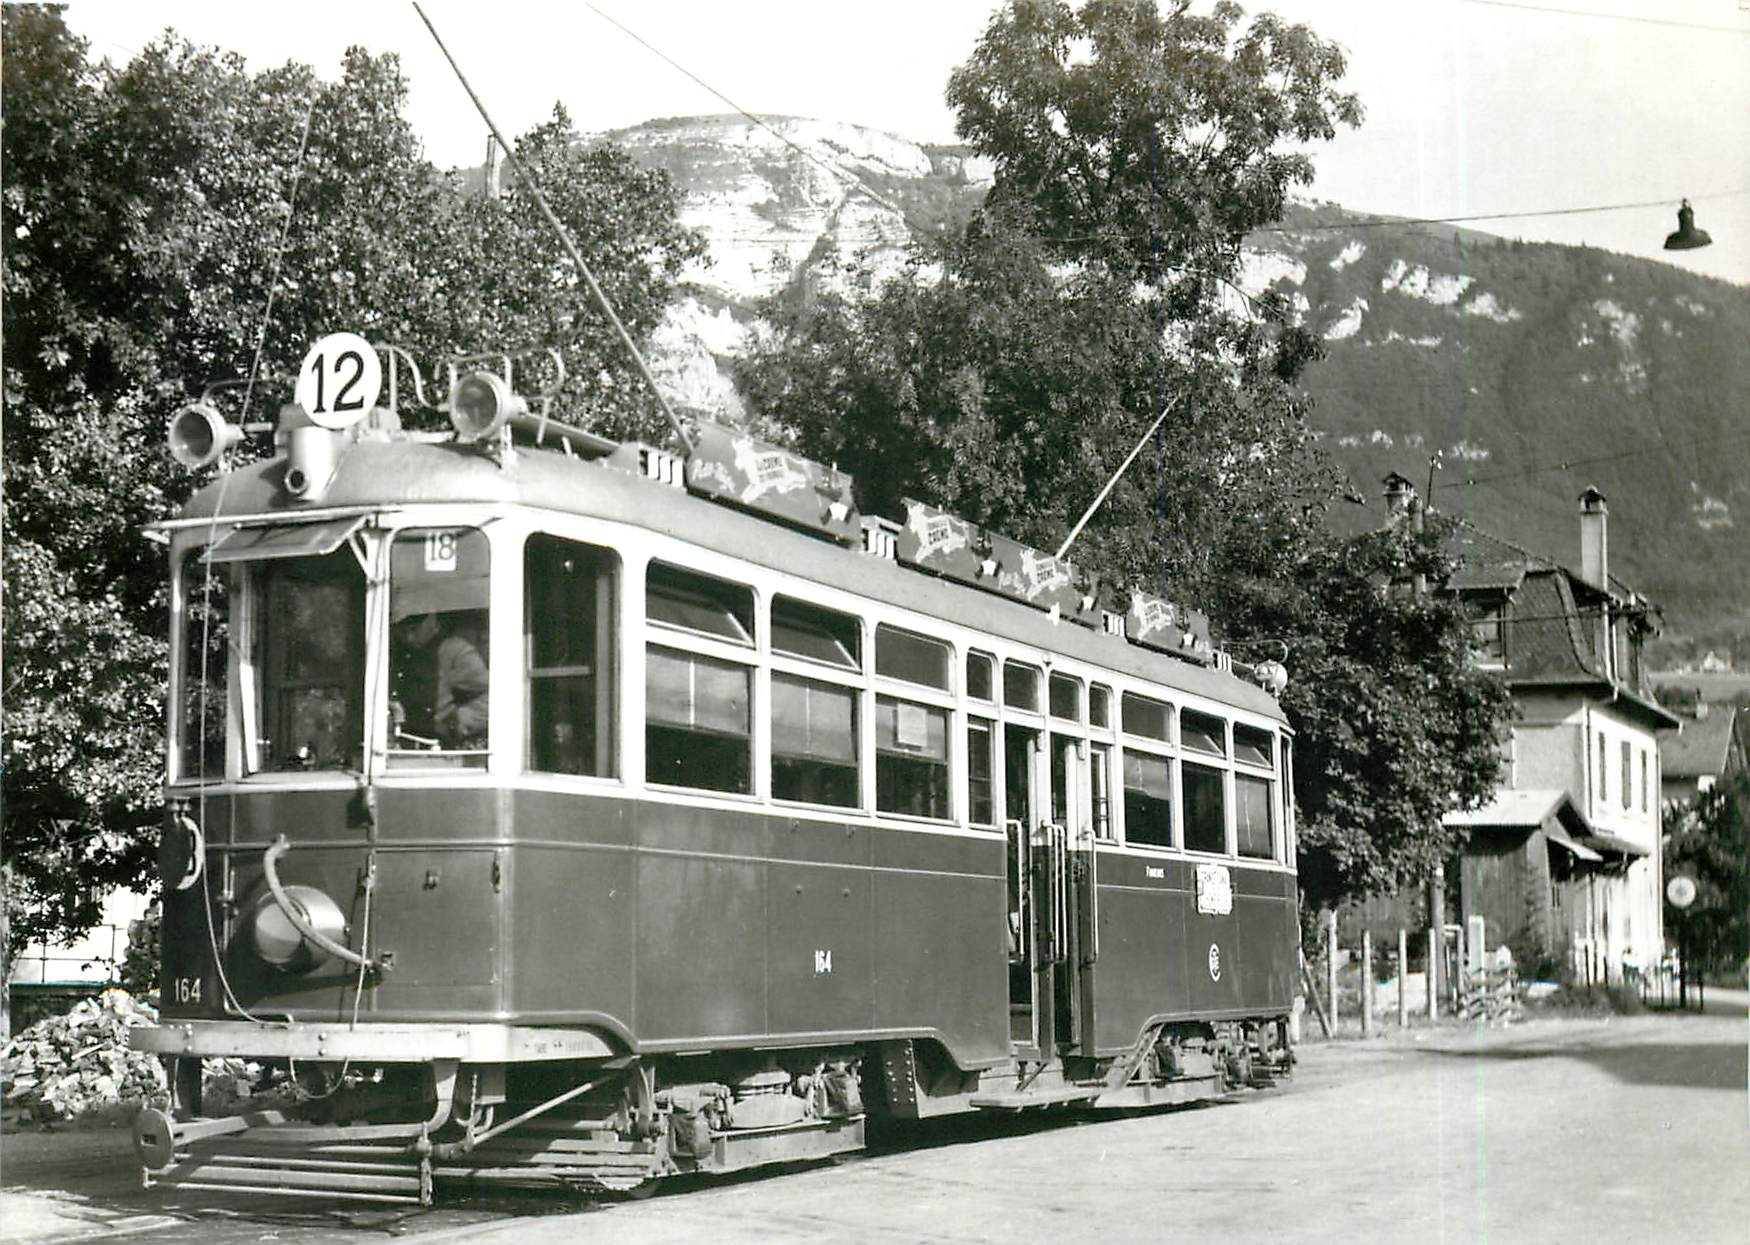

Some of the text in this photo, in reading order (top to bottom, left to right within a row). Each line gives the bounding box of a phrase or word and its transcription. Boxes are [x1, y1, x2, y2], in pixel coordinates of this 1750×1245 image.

[311, 350, 365, 414] 12
[430, 533, 455, 561] 18
[815, 949, 832, 973] 164
[175, 977, 201, 1003] 164
